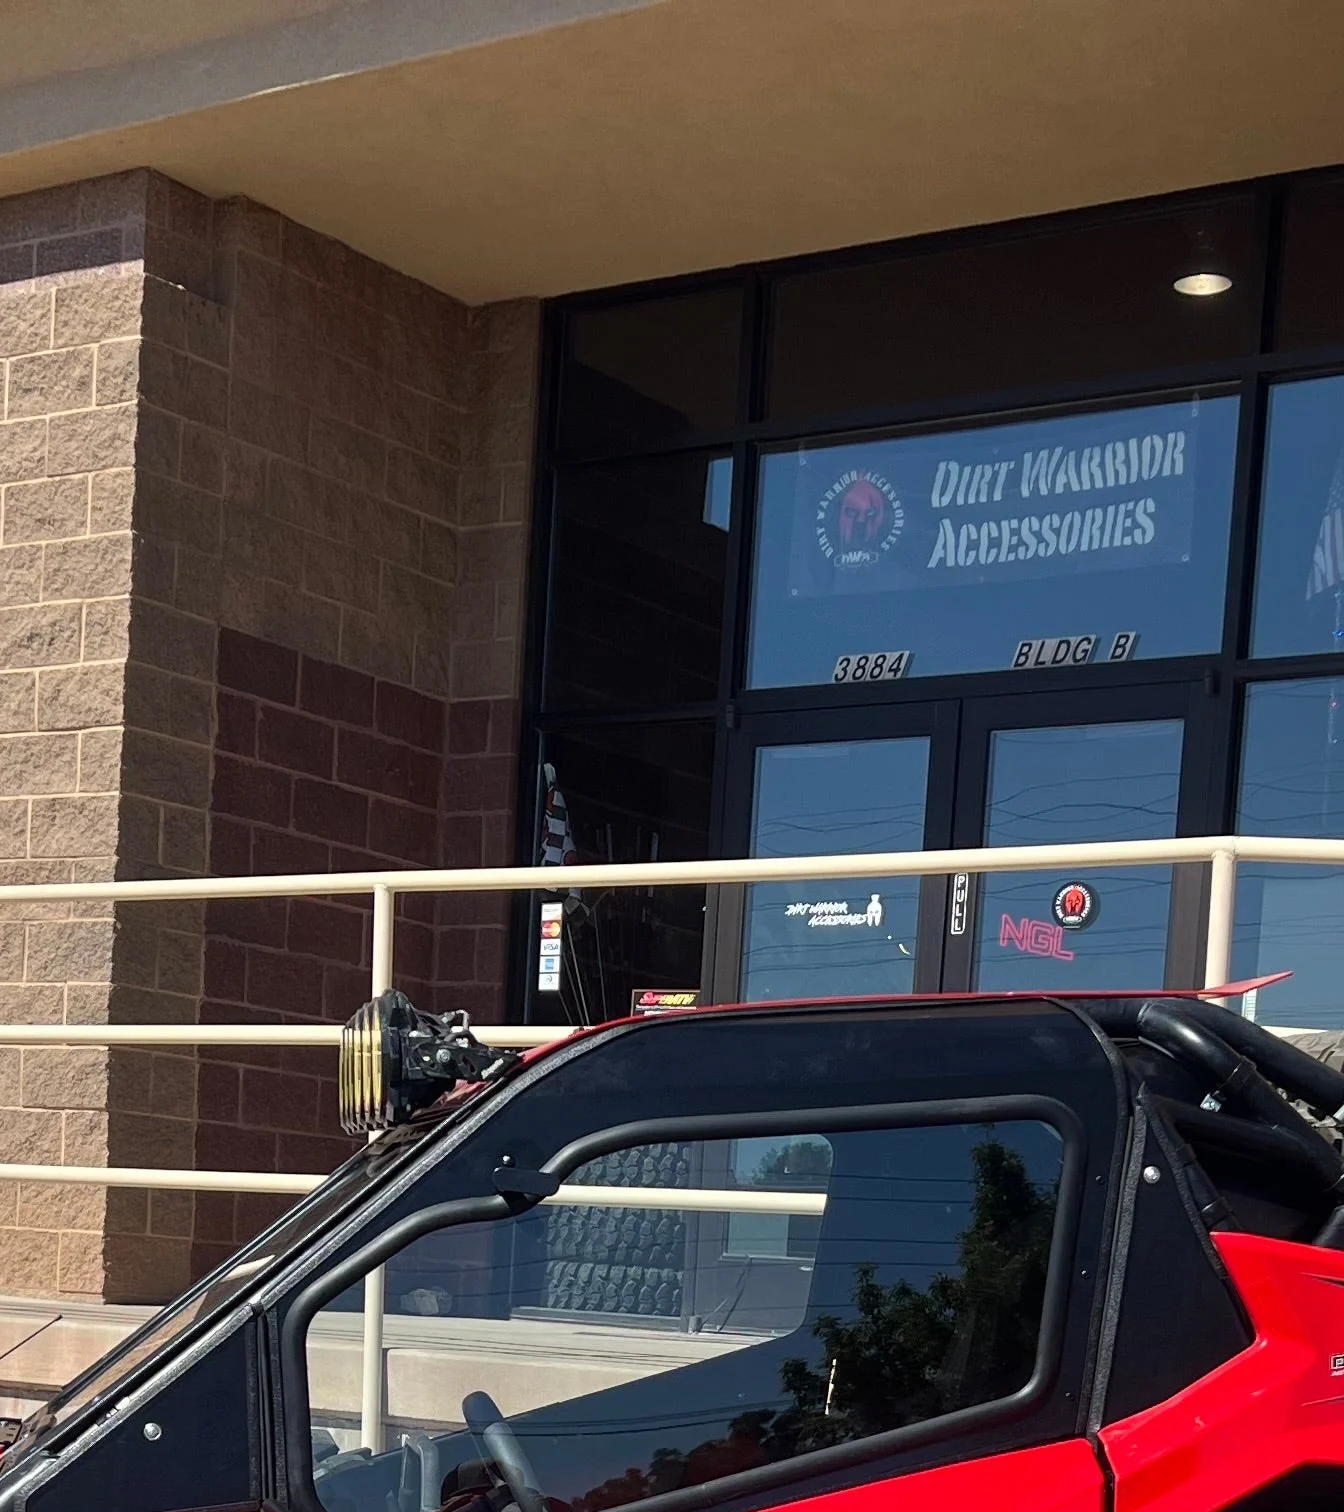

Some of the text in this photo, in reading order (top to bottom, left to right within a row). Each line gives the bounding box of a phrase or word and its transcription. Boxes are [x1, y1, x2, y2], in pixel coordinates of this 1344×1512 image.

[930, 431, 1186, 509] DIRT WARRIOR
[927, 496, 1156, 569] ACCESSORIES
[834, 656, 903, 683] 3884
[1013, 634, 1130, 668] BLDG B
[954, 875, 965, 931] PULL
[543, 943, 559, 951] VISA
[999, 913, 1076, 961] NGL
